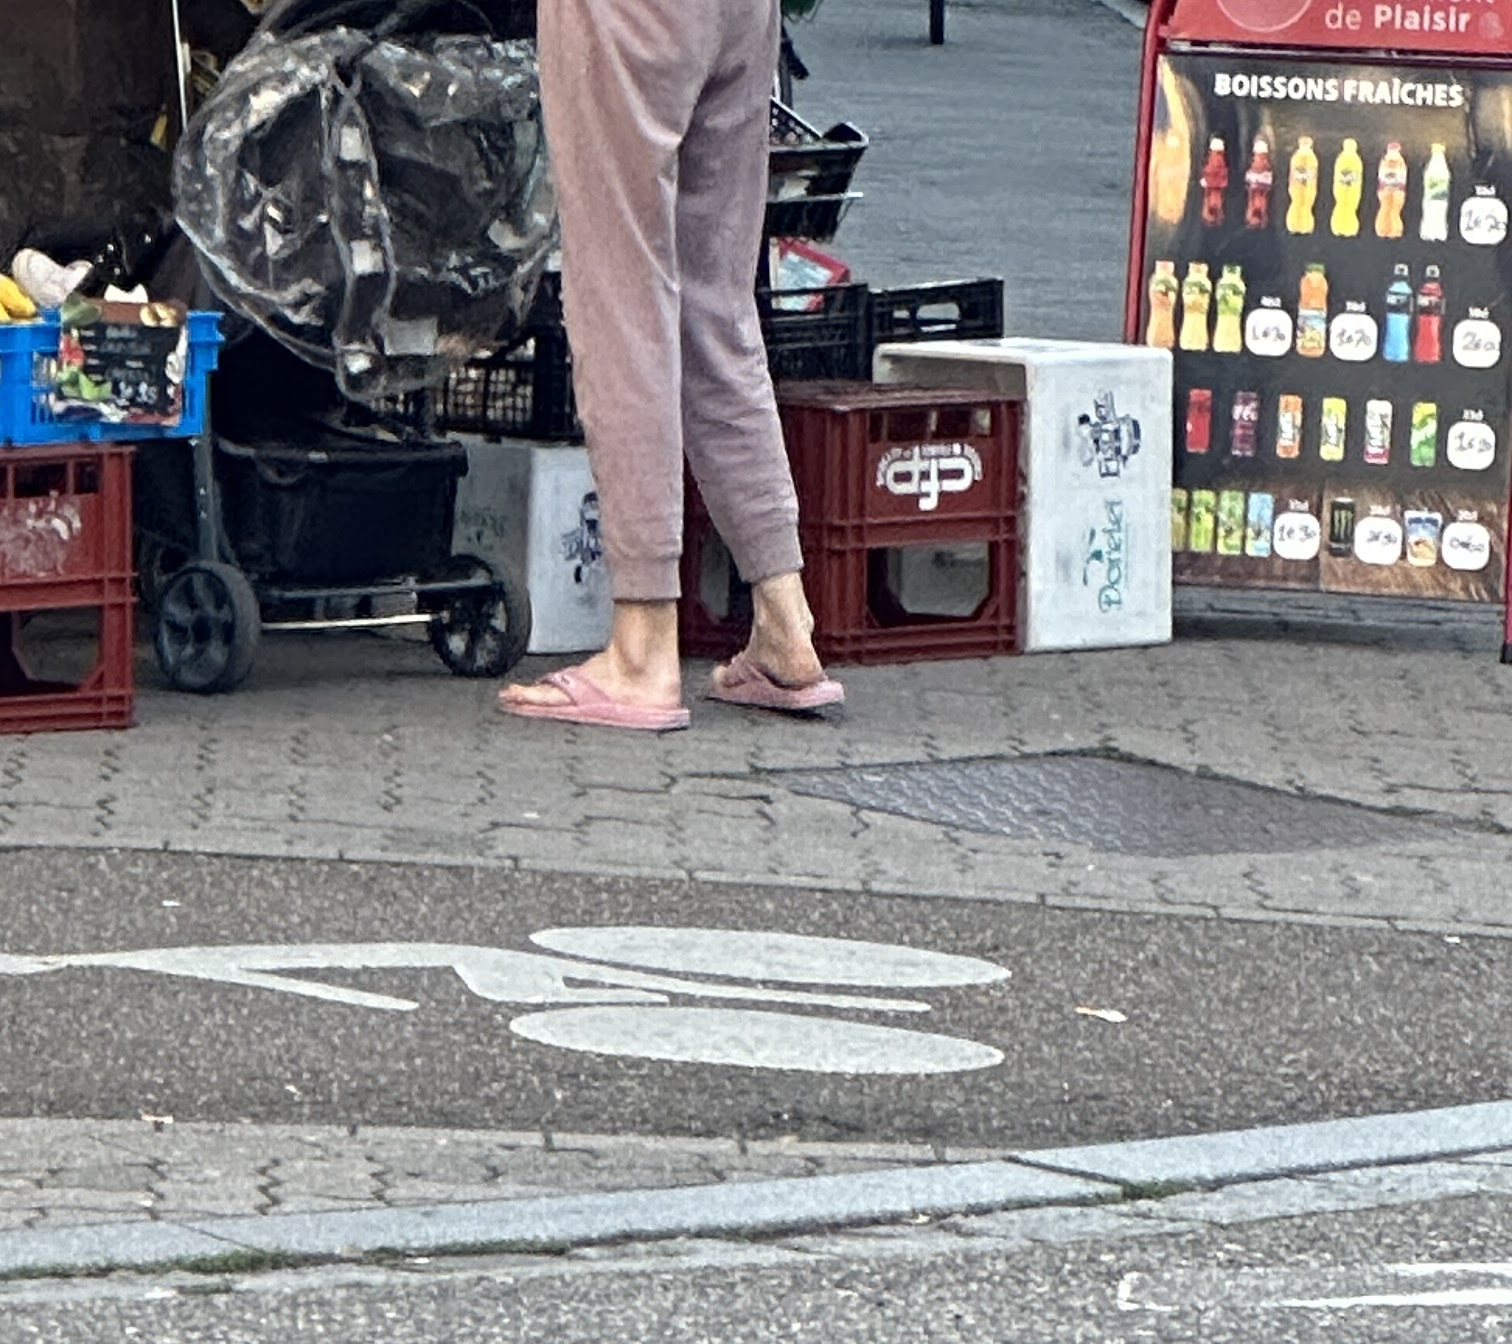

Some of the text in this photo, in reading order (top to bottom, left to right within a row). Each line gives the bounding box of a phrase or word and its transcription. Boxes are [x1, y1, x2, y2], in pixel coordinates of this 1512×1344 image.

[1325, 5, 1471, 33] de Plaisir
[1214, 73, 1339, 103] BOISSONS
